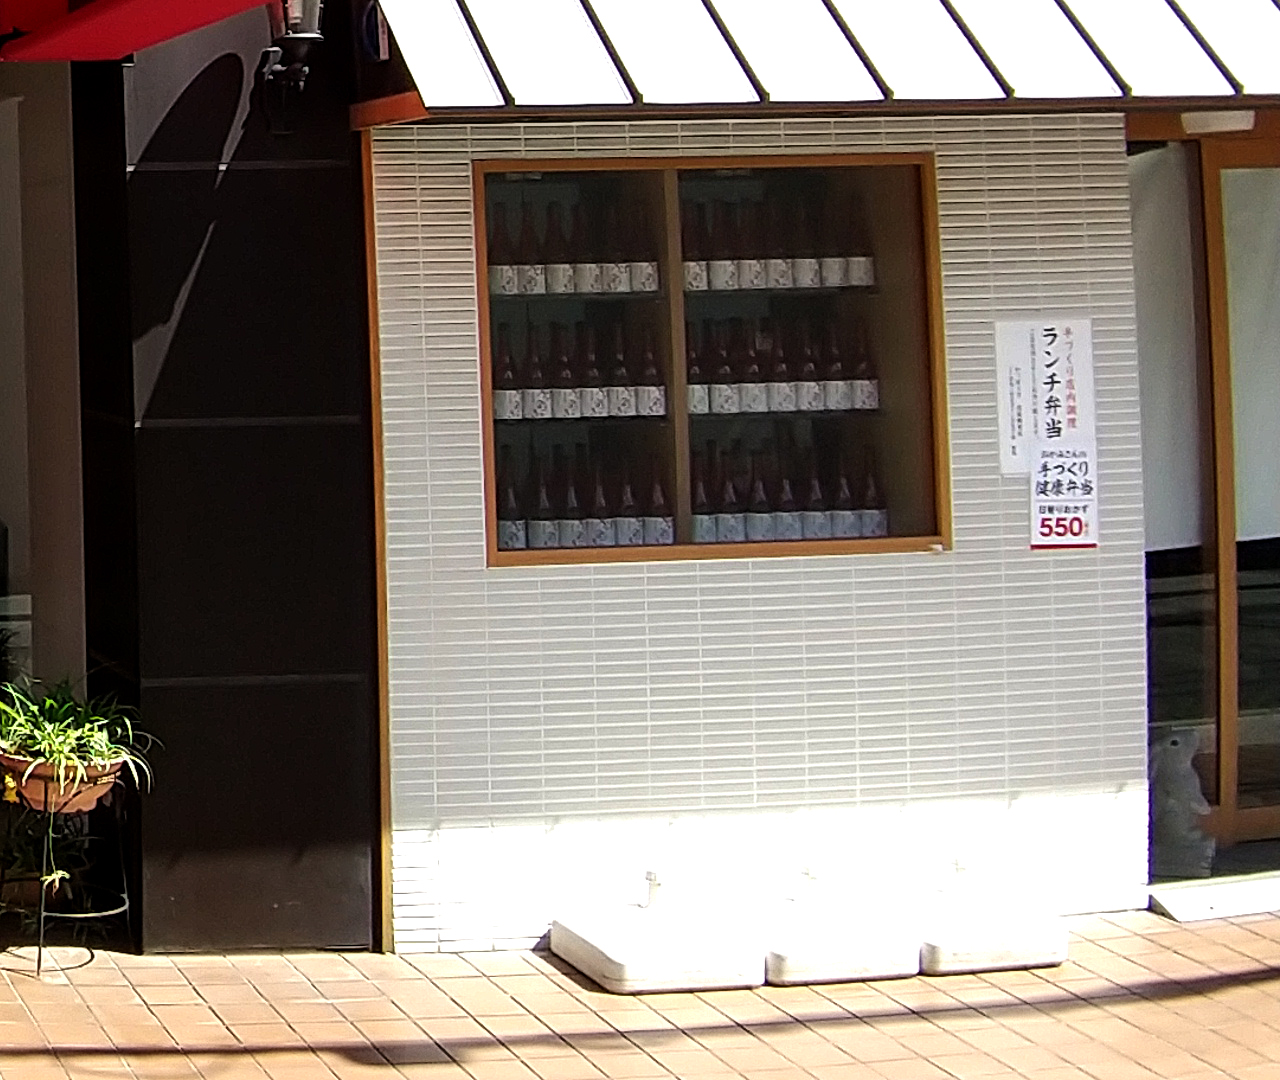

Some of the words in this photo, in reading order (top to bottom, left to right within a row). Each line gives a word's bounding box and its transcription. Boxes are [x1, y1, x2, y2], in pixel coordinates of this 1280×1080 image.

[1043, 327, 1062, 439] ランチ弁当
[1038, 461, 1089, 477] 手づくり
[1036, 479, 1093, 497] 健康弁当
[1039, 517, 1083, 537] 550
